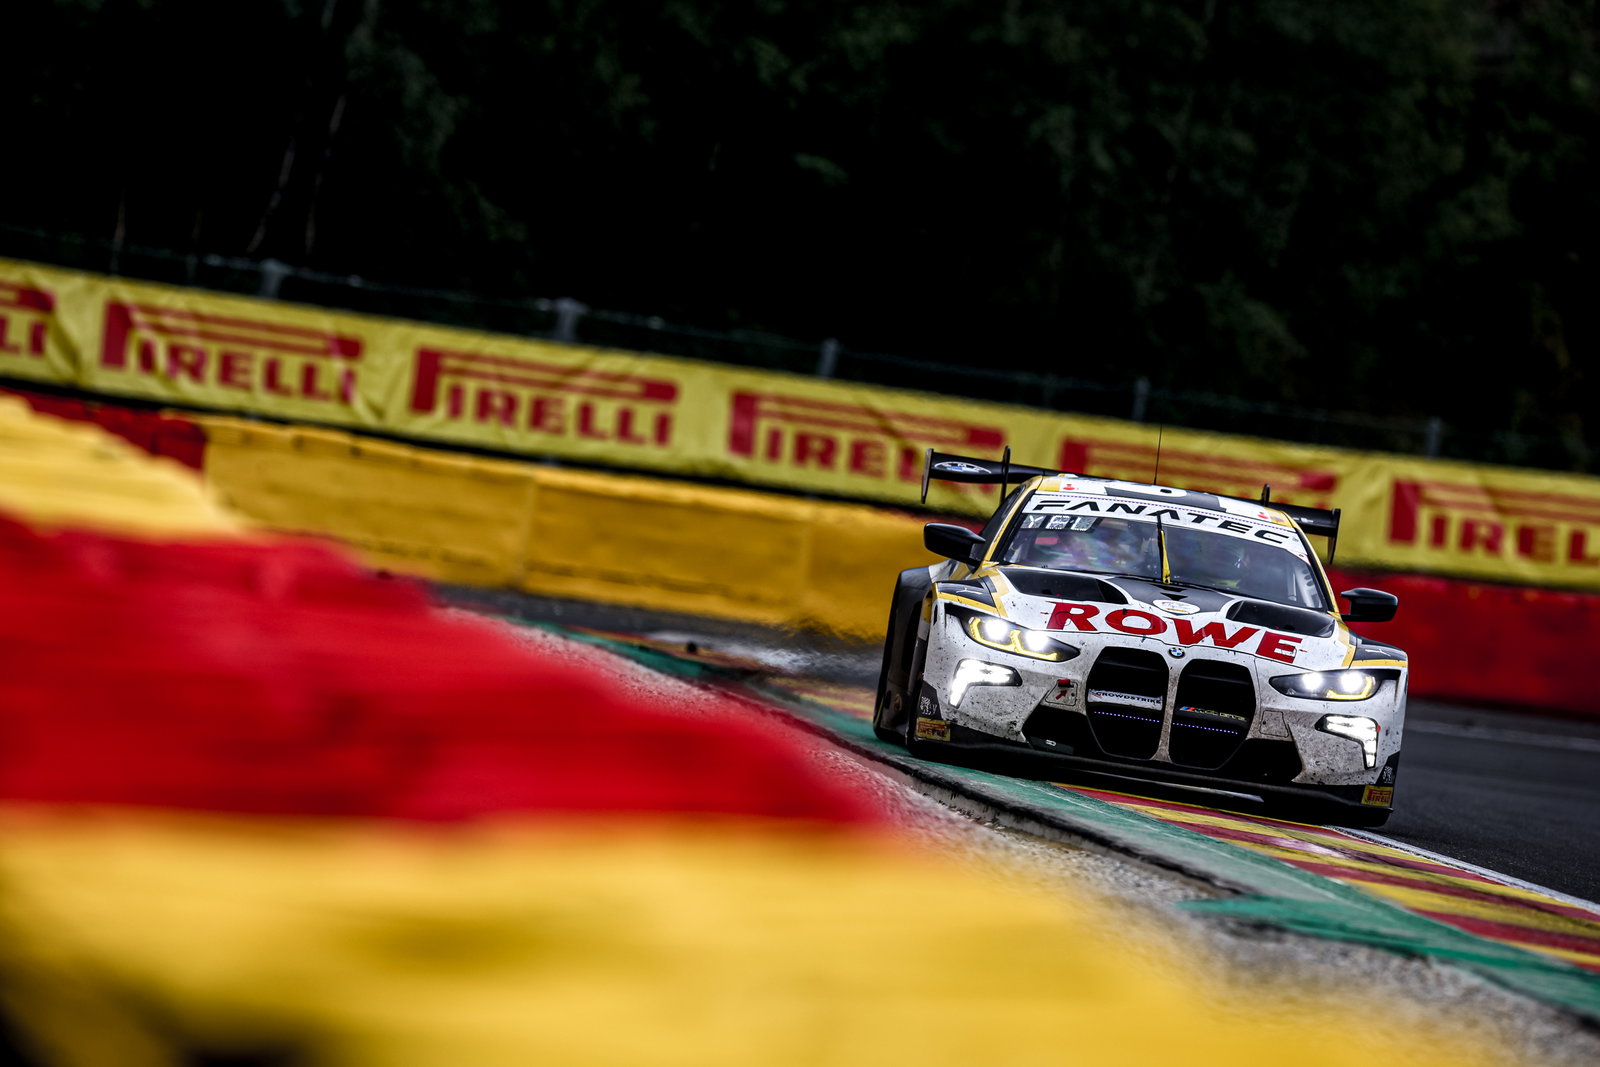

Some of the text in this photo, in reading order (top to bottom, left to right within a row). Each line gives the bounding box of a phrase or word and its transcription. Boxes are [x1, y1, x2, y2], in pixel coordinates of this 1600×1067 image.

[101, 299, 365, 405] PIRELLI
[410, 346, 679, 447] PIRELLI
[727, 390, 1007, 493] PIREL
[1032, 499, 1290, 545] FANATEC
[1046, 600, 1303, 664] ROWE
[1096, 691, 1162, 705] CROWDSTRIKE
